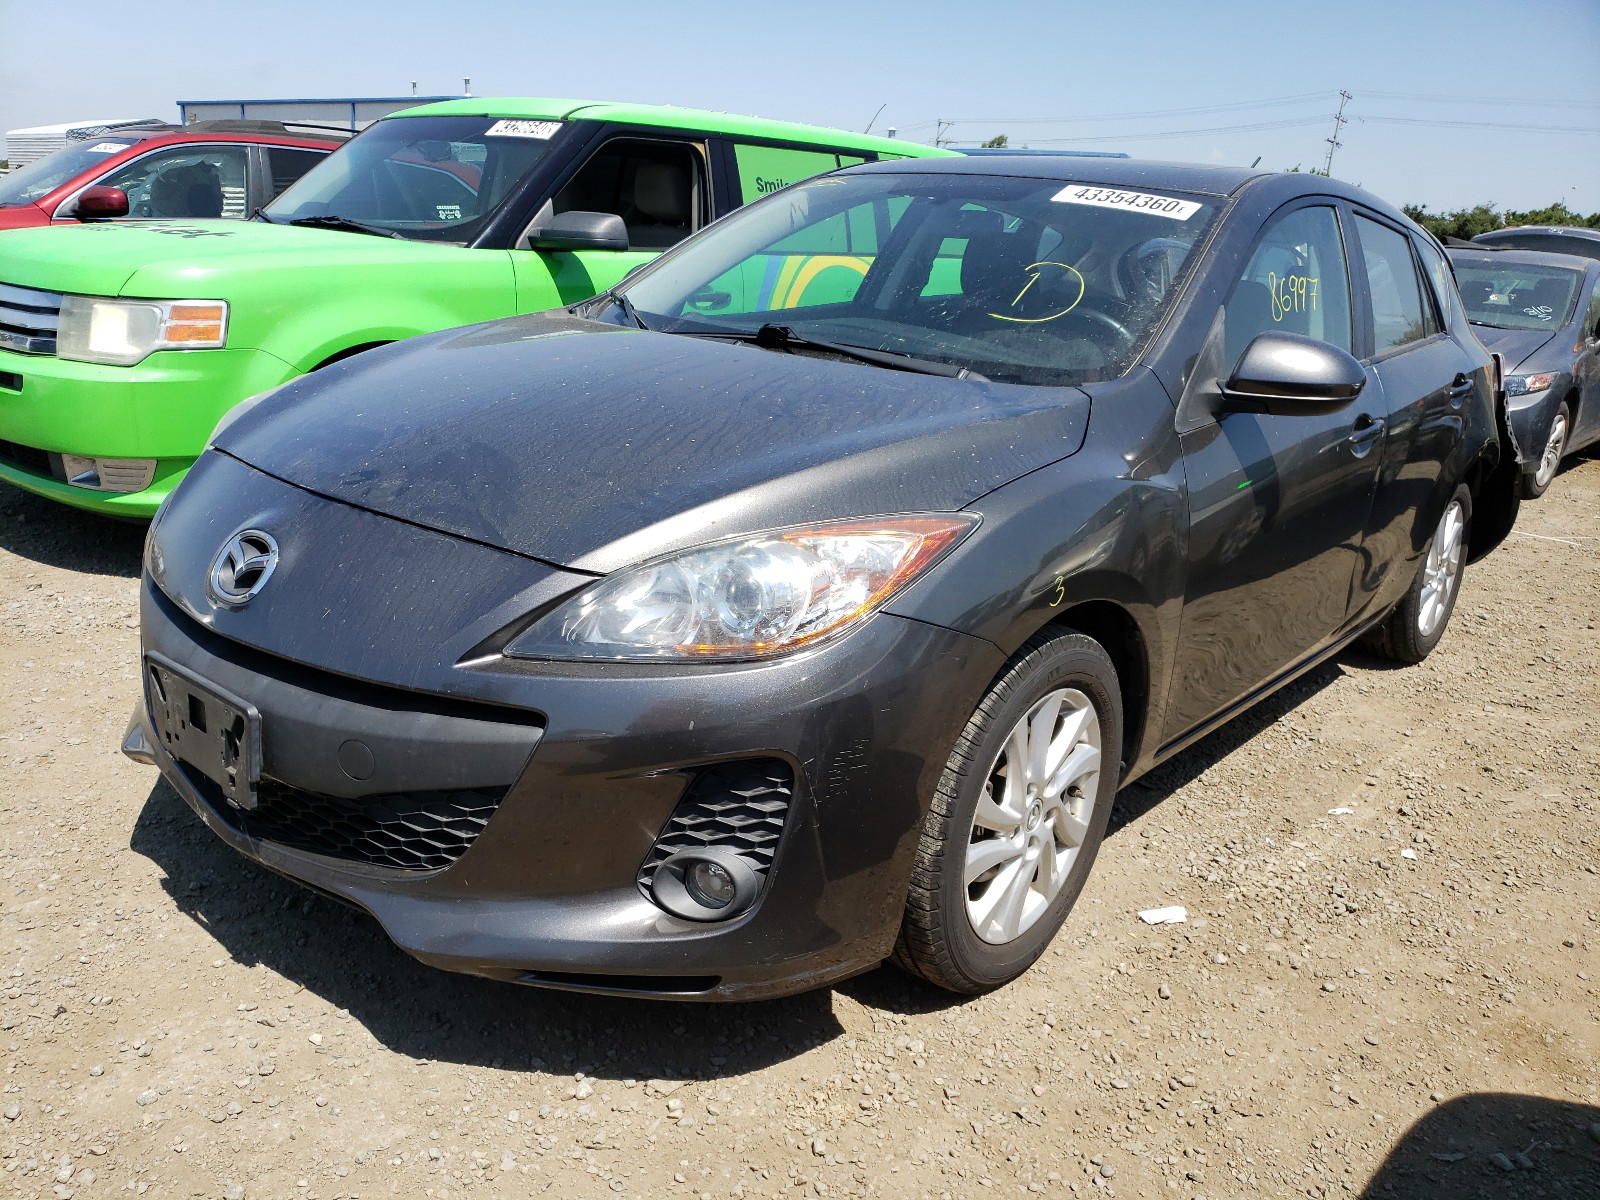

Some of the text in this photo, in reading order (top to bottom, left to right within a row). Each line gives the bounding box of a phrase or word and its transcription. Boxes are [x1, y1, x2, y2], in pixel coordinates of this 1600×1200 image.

[755, 176, 790, 193] Smil
[1074, 188, 1181, 213] 43354360
[1268, 271, 1319, 322] 86997
